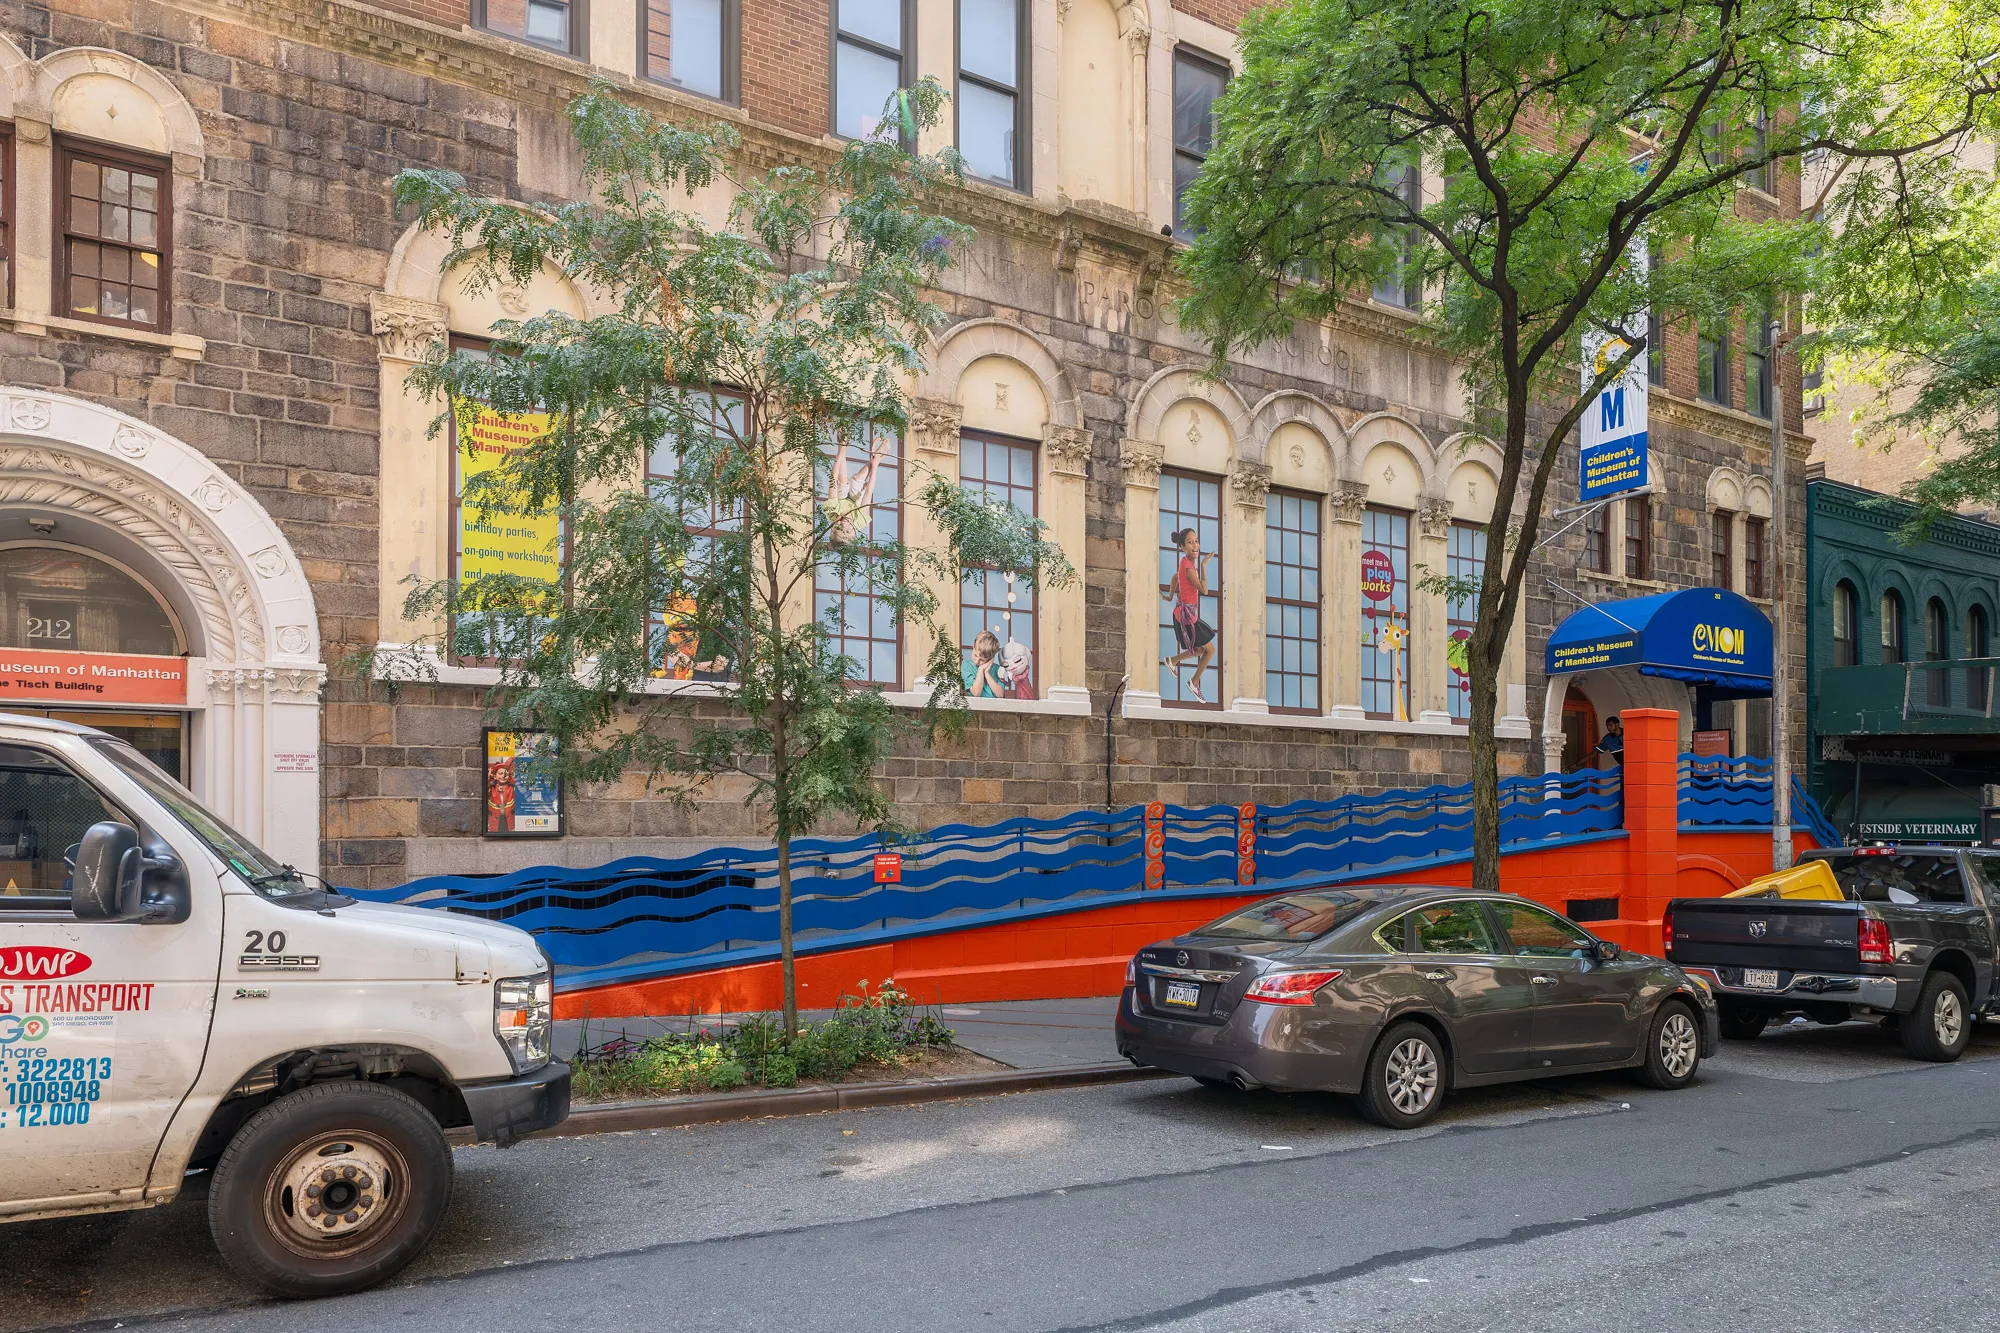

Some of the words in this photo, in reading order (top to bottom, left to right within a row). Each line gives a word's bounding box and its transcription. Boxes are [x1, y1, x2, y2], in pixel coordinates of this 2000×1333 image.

[474, 414, 539, 433] Children's
[472, 427, 530, 444] Museum
[1587, 447, 1634, 466] Children's
[1587, 461, 1627, 478] Museum
[1629, 456, 1640, 466] of
[1587, 470, 1639, 489] Manhattan
[464, 519, 503, 537] birthday
[506, 527, 538, 540] parties,
[464, 546, 504, 560] on-going
[507, 549, 556, 565] workshops,
[1361, 558, 1374, 566] meet
[1384, 559, 1389, 567] in
[464, 568, 482, 579] and
[1367, 567, 1391, 583] play
[1360, 580, 1391, 593] works
[26, 617, 71, 639] 212
[1554, 645, 1595, 657] Children's
[1596, 640, 1633, 652] Museum
[1693, 623, 1744, 655] CMOM
[1554, 660, 1563, 668] of
[1565, 655, 1610, 667] Manhattan
[66, 664, 85, 676] of
[91, 665, 181, 680] Manhattan
[15, 679, 49, 689] Tisch
[54, 681, 104, 693] Building
[1852, 823, 1901, 834] ESTSIDE
[1905, 823, 1977, 834] VETERINARY
[243, 930, 286, 953] 20
[240, 955, 319, 965] E-350
[23, 983, 154, 1013] TRANSPORT
[1, 1044, 47, 1058] hare
[17, 1057, 112, 1082] 3222813
[5, 1080, 100, 1105] 1008948
[15, 1102, 90, 1127] 12.000
